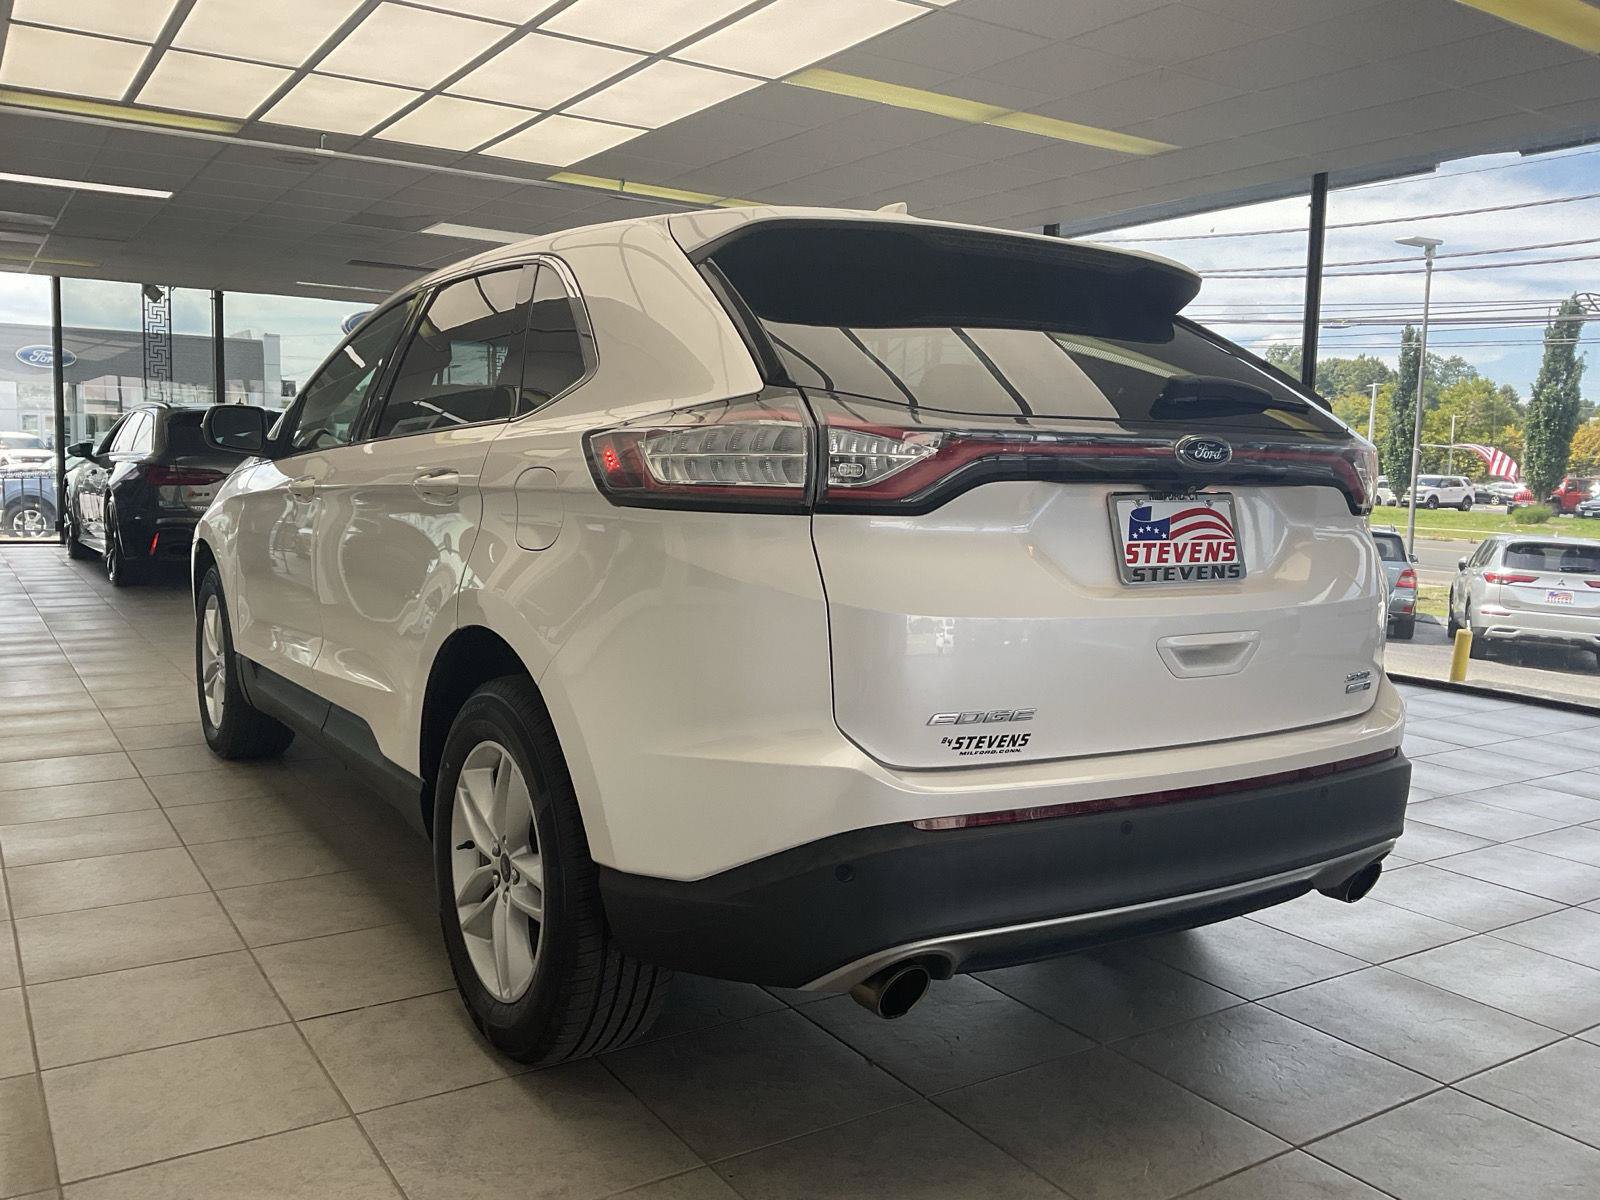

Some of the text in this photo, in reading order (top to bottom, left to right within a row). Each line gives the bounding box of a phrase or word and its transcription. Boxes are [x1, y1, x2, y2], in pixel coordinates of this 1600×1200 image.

[29, 349, 53, 363] For
[1194, 442, 1223, 459] Ford
[1126, 542, 1236, 564] STEVENS
[1132, 564, 1240, 582] STEVENS
[926, 708, 1038, 726] EDGE
[952, 732, 1032, 750] STEVENS
